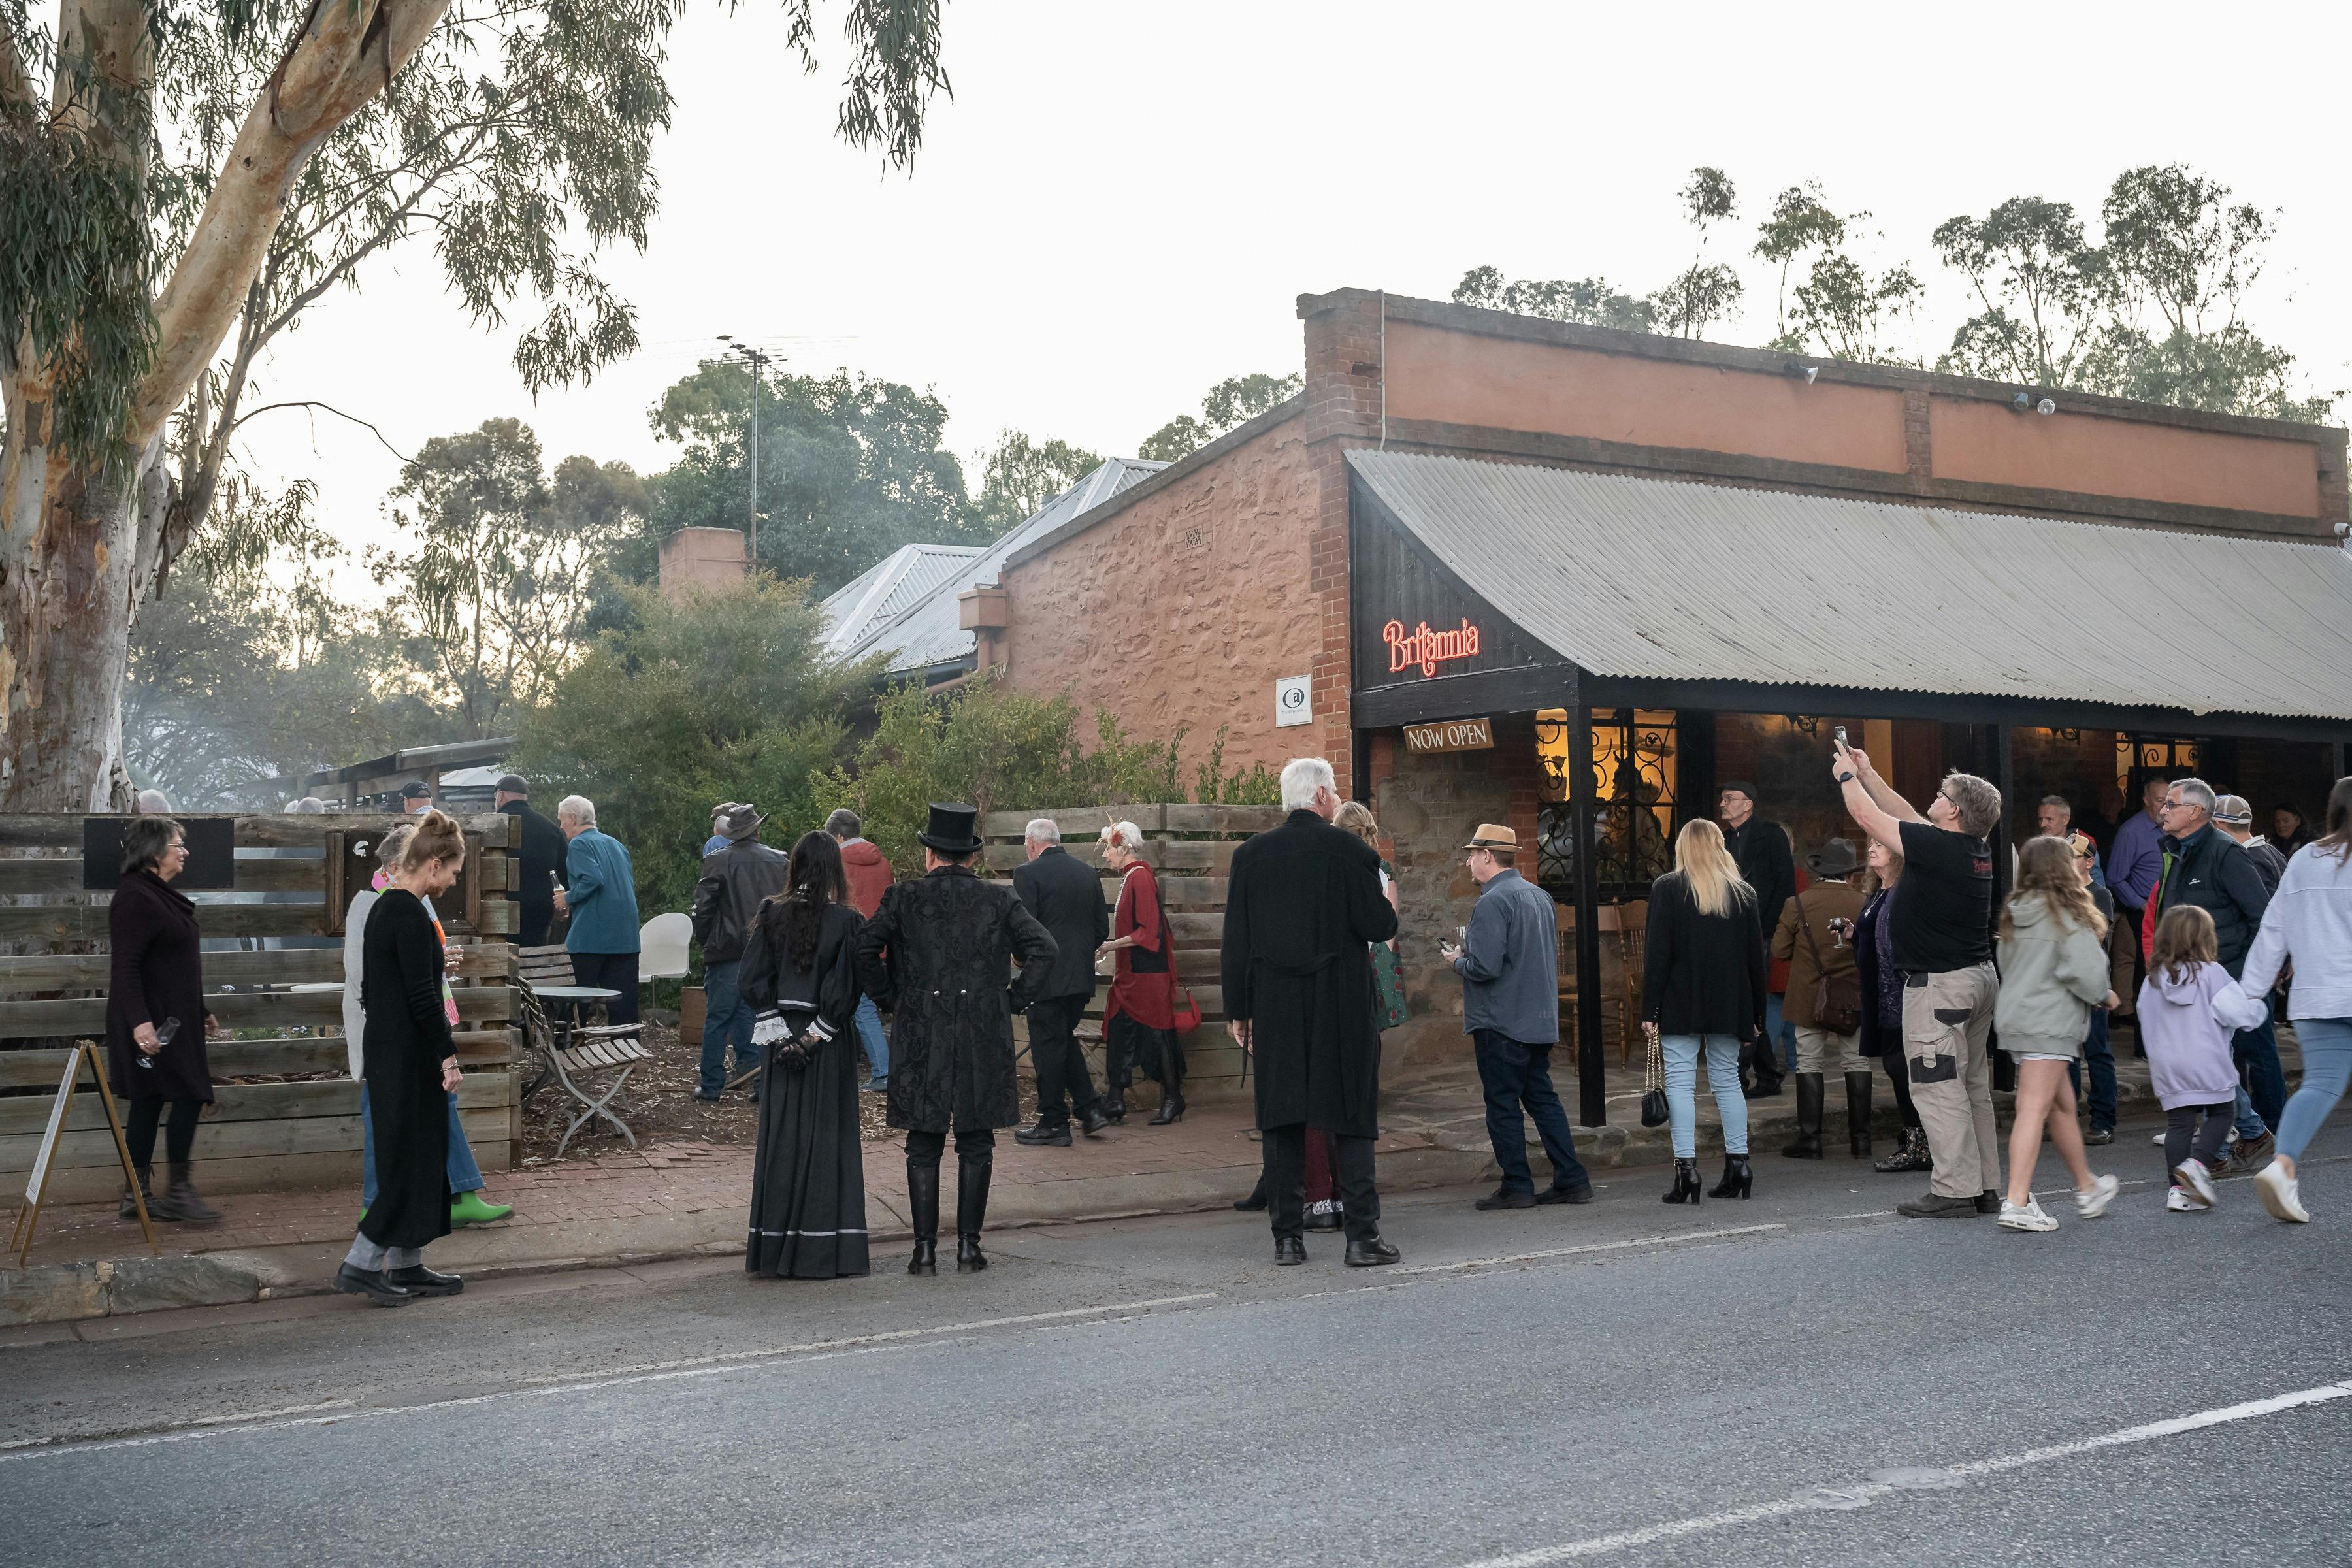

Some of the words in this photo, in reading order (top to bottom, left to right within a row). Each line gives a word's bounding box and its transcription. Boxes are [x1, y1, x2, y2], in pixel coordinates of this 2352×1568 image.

[1382, 617, 1480, 678] Britannia
[1409, 727, 1443, 751] NOW
[1448, 723, 1487, 746] OPEN
